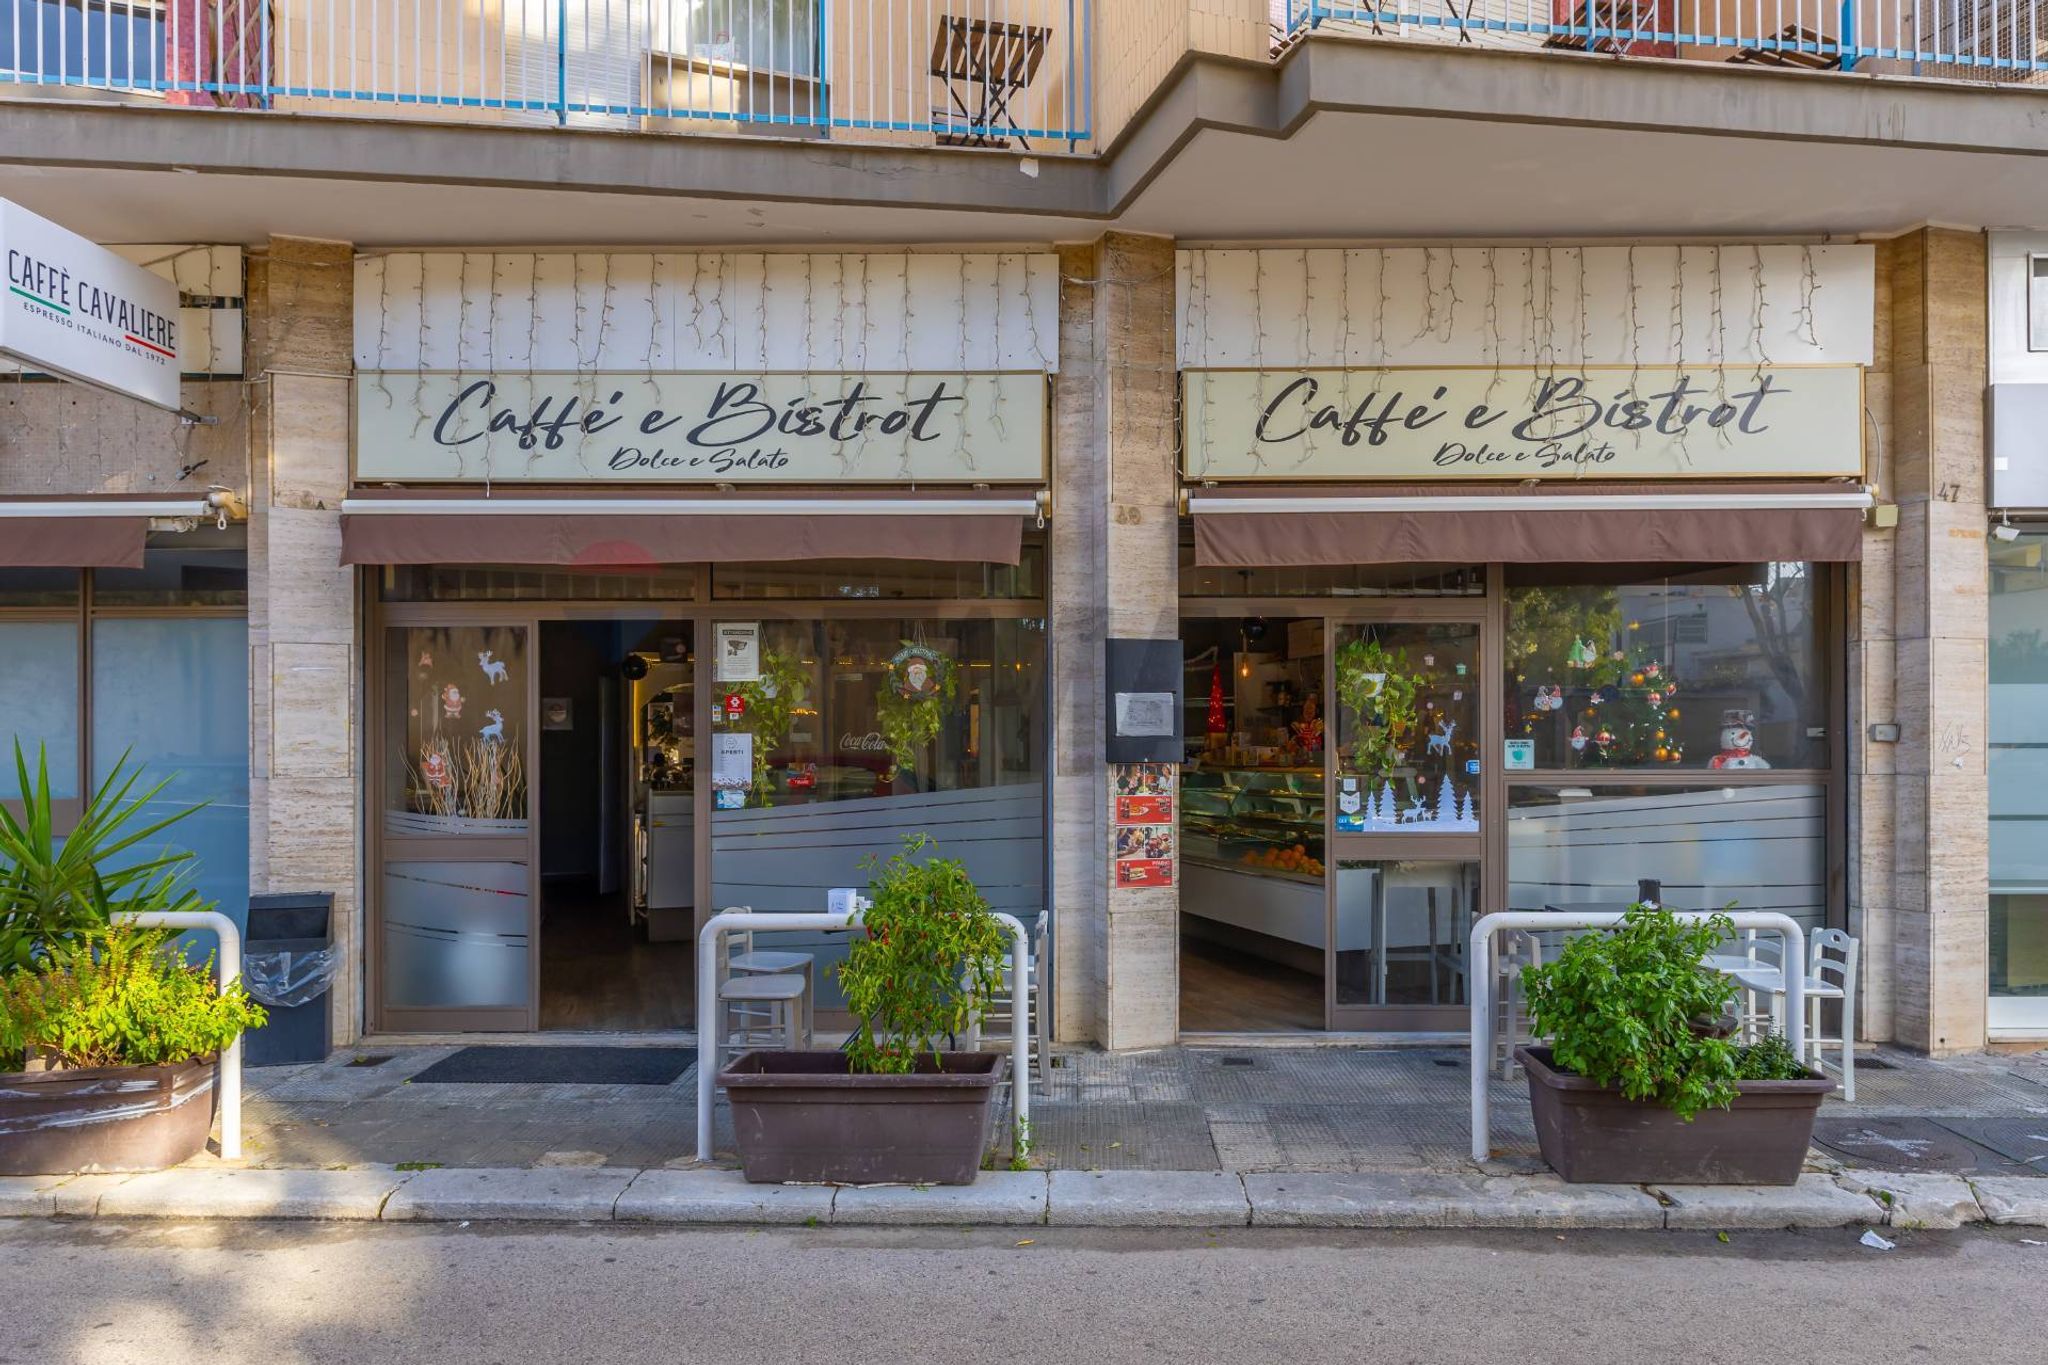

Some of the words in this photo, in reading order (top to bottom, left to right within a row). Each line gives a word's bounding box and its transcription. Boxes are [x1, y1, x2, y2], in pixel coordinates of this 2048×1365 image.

[8, 249, 71, 306] CAFFÈ
[78, 281, 176, 350] CAVALIERE
[23, 302, 73, 328] ESPRESSO
[77, 324, 122, 348] ITALIANO
[125, 343, 142, 357] DAL
[145, 351, 165, 365] 1972
[640, 409, 683, 434] e
[686, 382, 964, 447] Bistrot
[1464, 404, 1508, 429] e
[1511, 374, 1792, 442] Bistrot
[608, 447, 686, 470] Dolce
[689, 457, 705, 467] e
[708, 447, 788, 473] Salato
[1432, 442, 1511, 467] Dolce
[1515, 452, 1530, 461] e
[1535, 442, 1615, 469] Salato
[1937, 481, 1960, 502] 47
